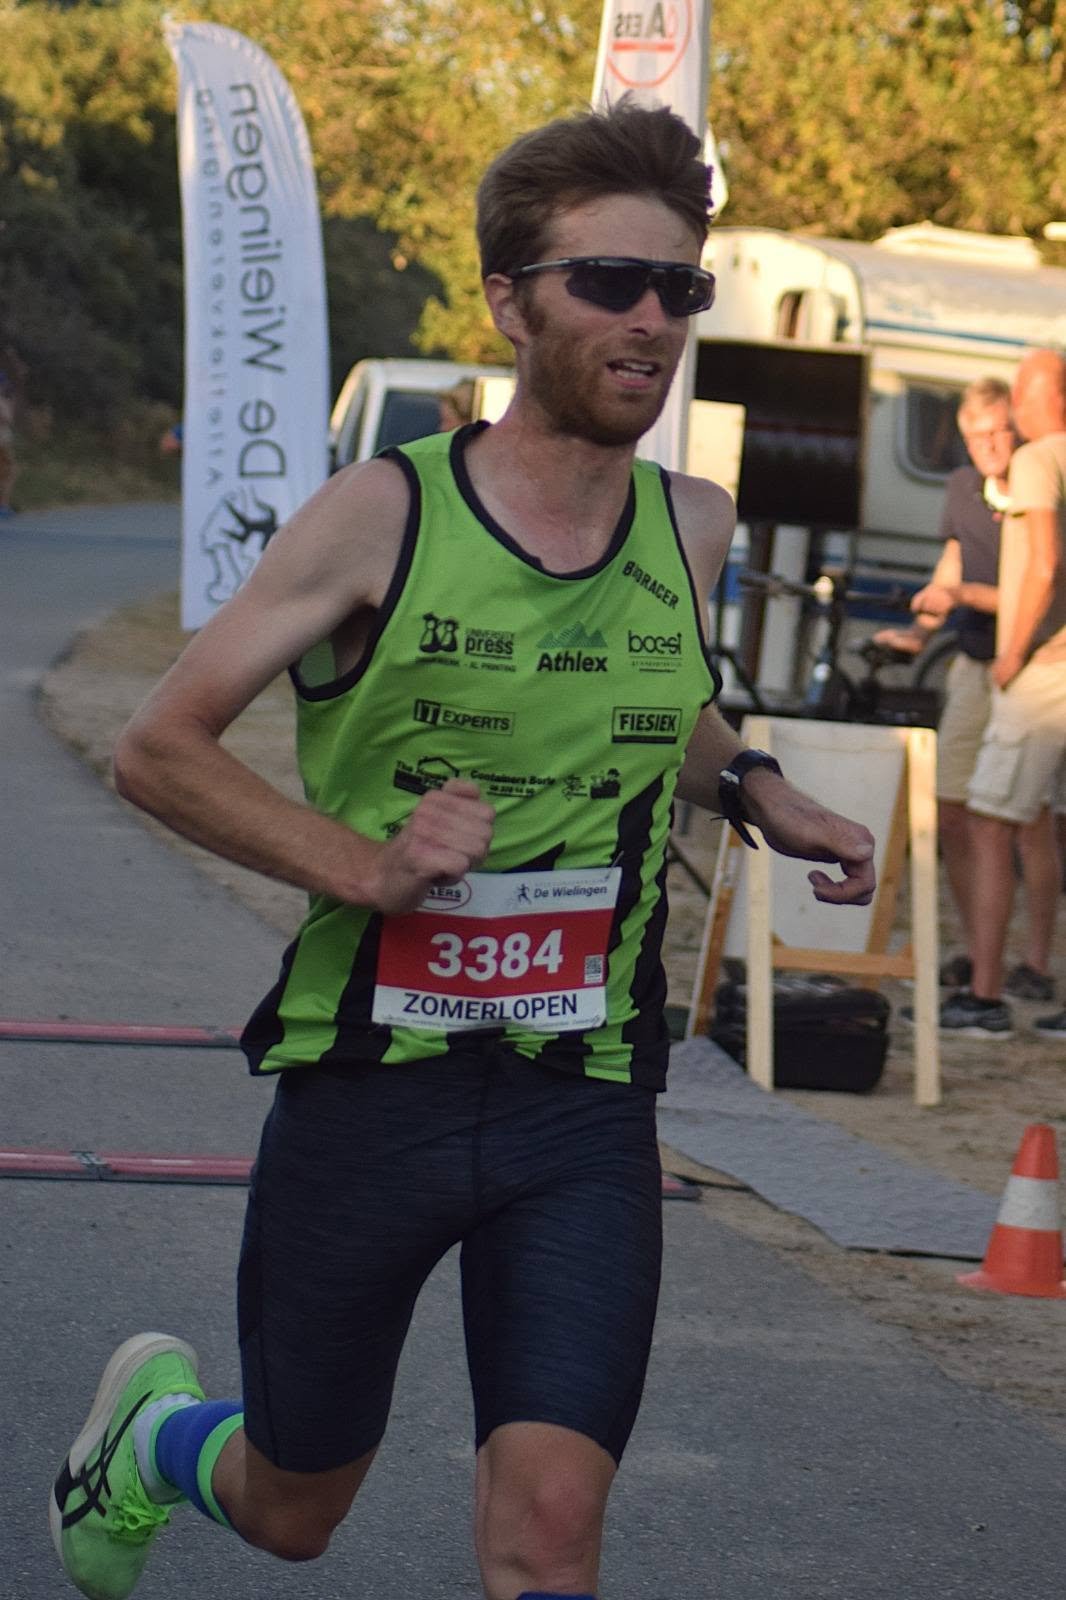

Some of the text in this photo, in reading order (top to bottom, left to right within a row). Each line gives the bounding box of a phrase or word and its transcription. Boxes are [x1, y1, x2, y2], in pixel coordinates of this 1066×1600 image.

[464, 635, 514, 655] press
[537, 650, 609, 673] Athlex
[442, 709, 511, 731] EXPERTS
[619, 713, 677, 732] FIESIEK
[534, 885, 608, 898] De Wielingen
[427, 929, 564, 982] 3384
[403, 992, 577, 1021] ZOMERLOPEN
